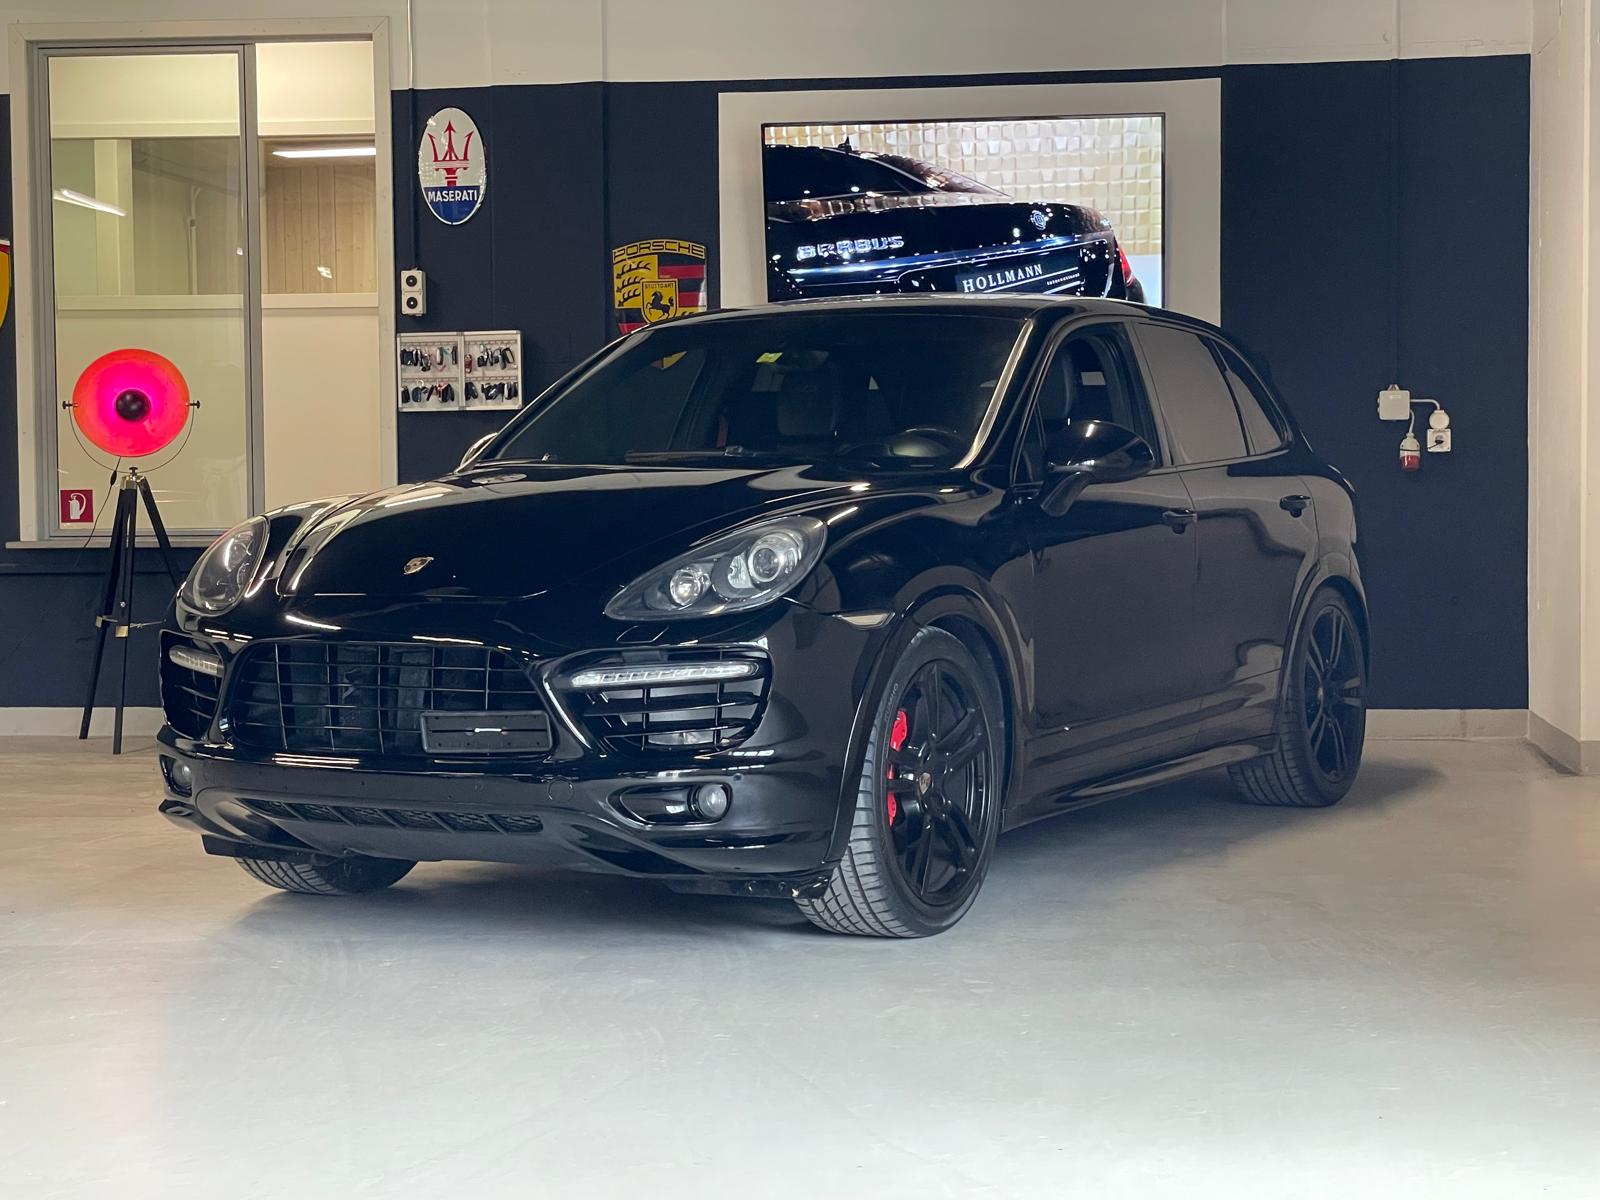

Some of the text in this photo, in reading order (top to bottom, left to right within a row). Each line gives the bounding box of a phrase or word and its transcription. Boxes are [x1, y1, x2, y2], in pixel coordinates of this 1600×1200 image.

[427, 189, 478, 202] MASERATI
[613, 240, 705, 261] PORSCHE
[796, 235, 905, 261] BRABUS
[962, 263, 1043, 293] HOLLMANN
